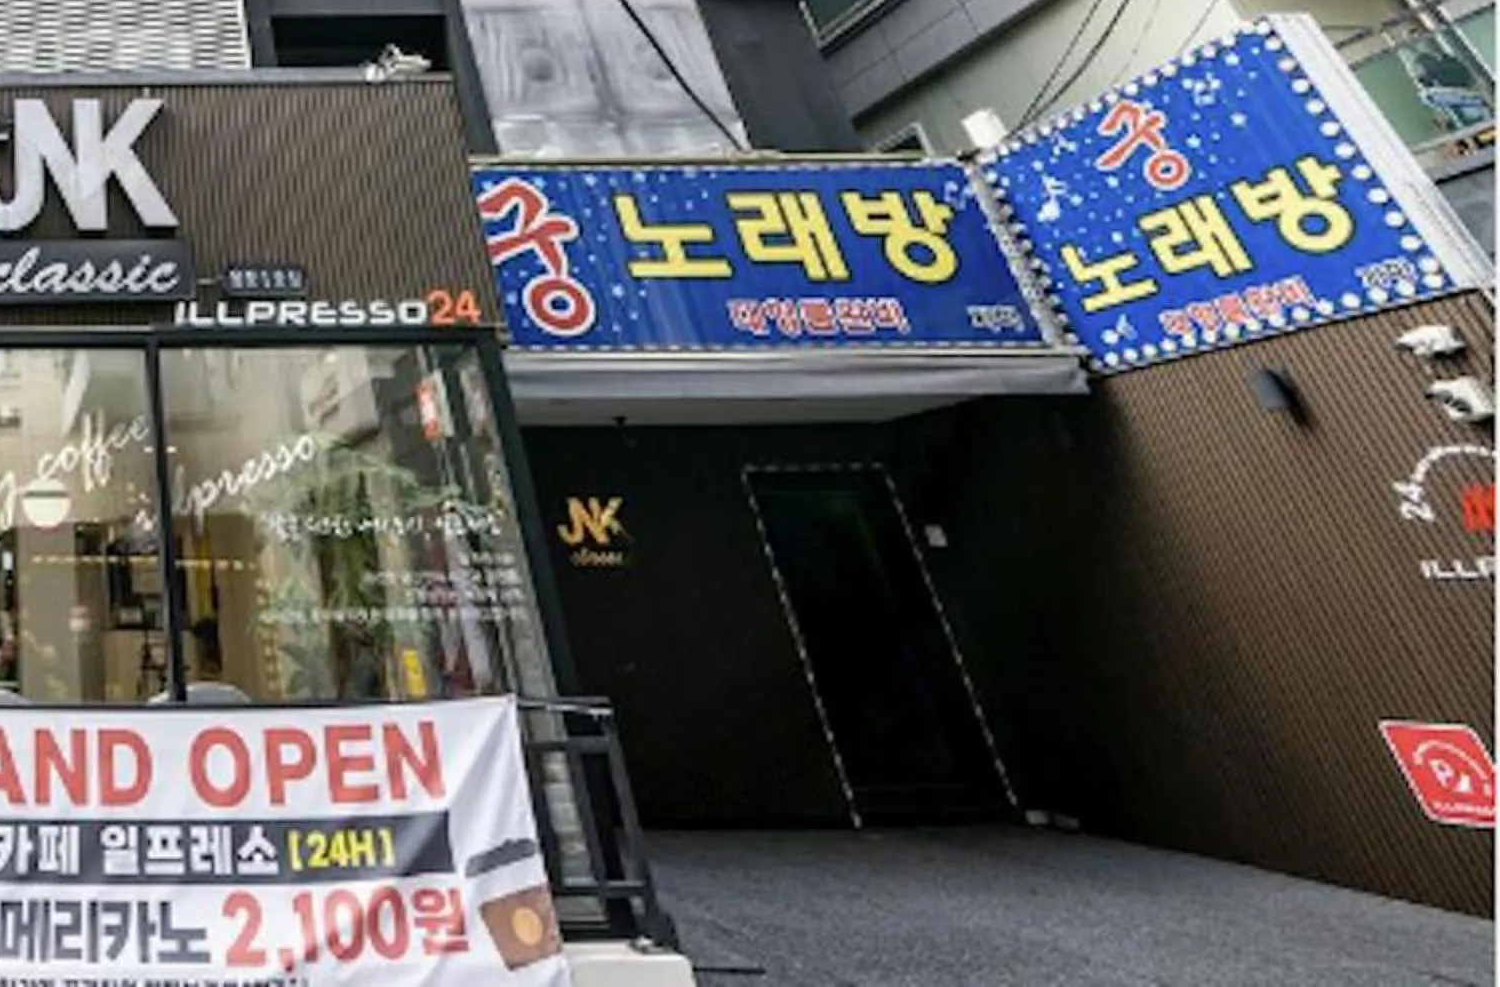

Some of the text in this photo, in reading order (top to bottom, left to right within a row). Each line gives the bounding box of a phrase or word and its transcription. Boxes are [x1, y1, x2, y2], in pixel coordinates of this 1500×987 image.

[613, 190, 958, 284] 노래방
[1059, 155, 1355, 313] 노래방
[35, 411, 151, 491] coffee
[135, 435, 316, 535] ilpresso
[189, 721, 446, 809] OPEN
[101, 824, 280, 877] 일프레소
[221, 884, 470, 973] 2,100원
